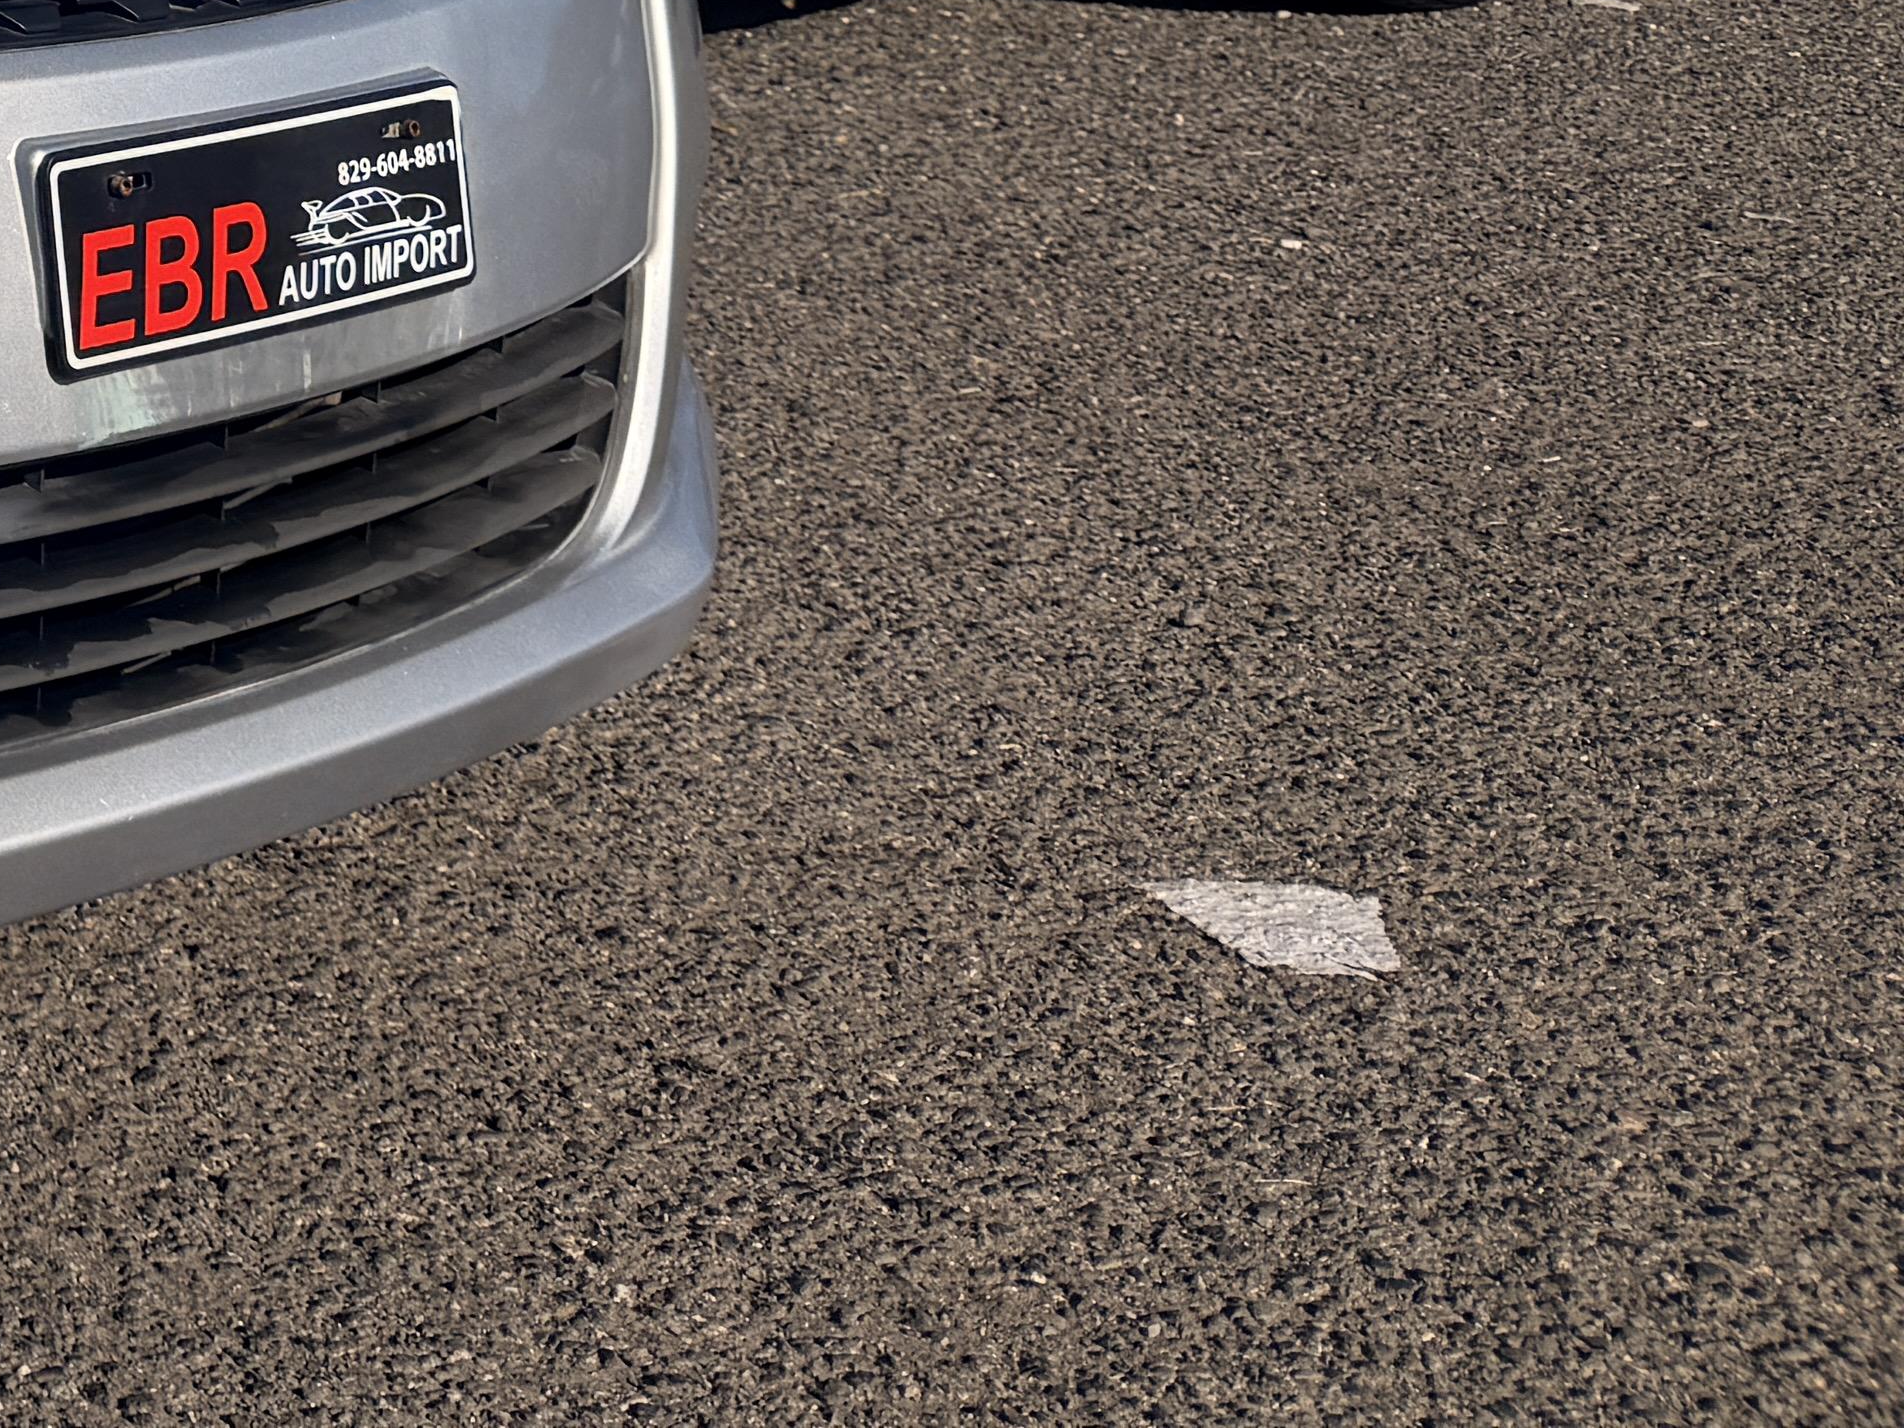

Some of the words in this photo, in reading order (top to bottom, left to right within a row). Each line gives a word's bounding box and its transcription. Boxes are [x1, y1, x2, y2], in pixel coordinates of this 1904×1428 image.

[337, 138, 456, 186] 829-604-8811
[78, 201, 269, 351] EBR
[278, 250, 356, 306] AUTO
[363, 224, 463, 285] IMPORT
